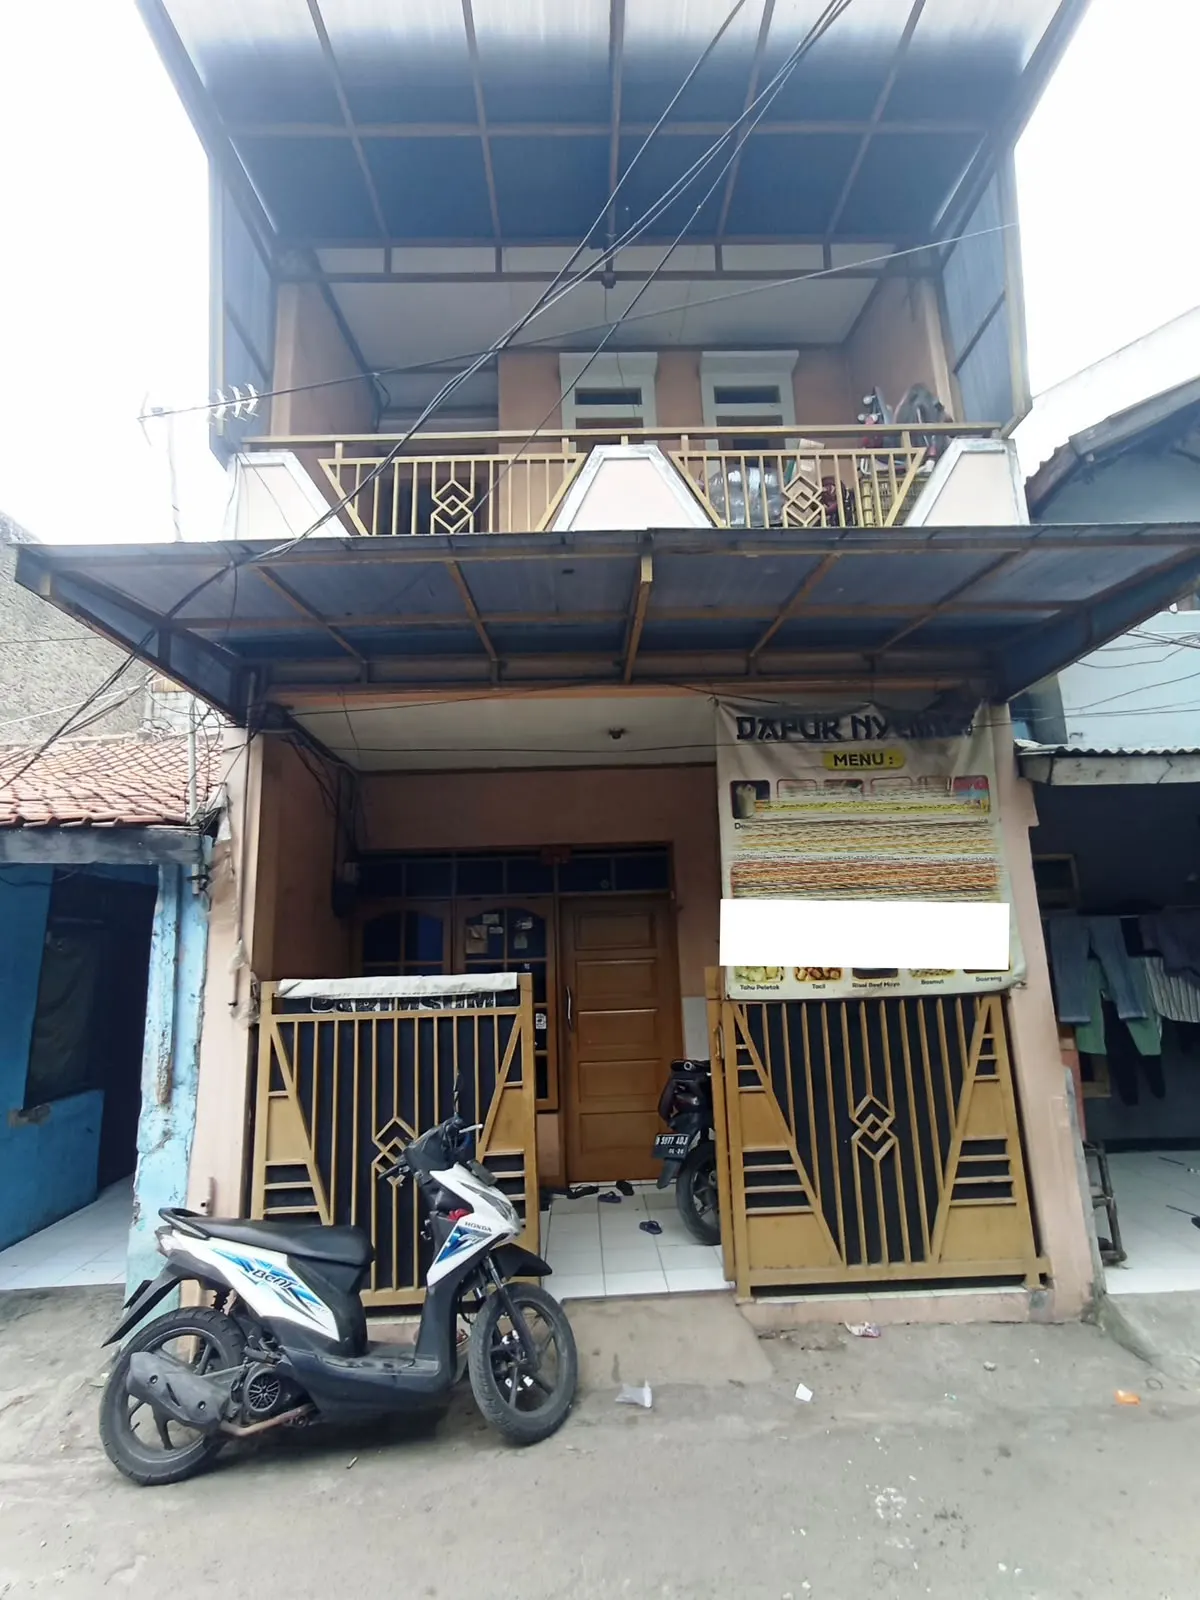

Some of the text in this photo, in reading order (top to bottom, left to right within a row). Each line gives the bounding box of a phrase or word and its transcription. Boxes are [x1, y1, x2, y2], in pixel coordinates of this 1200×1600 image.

[736, 716, 842, 741] DAPUR
[833, 753, 885, 767] MENU
[464, 1221, 493, 1232] HONDA
